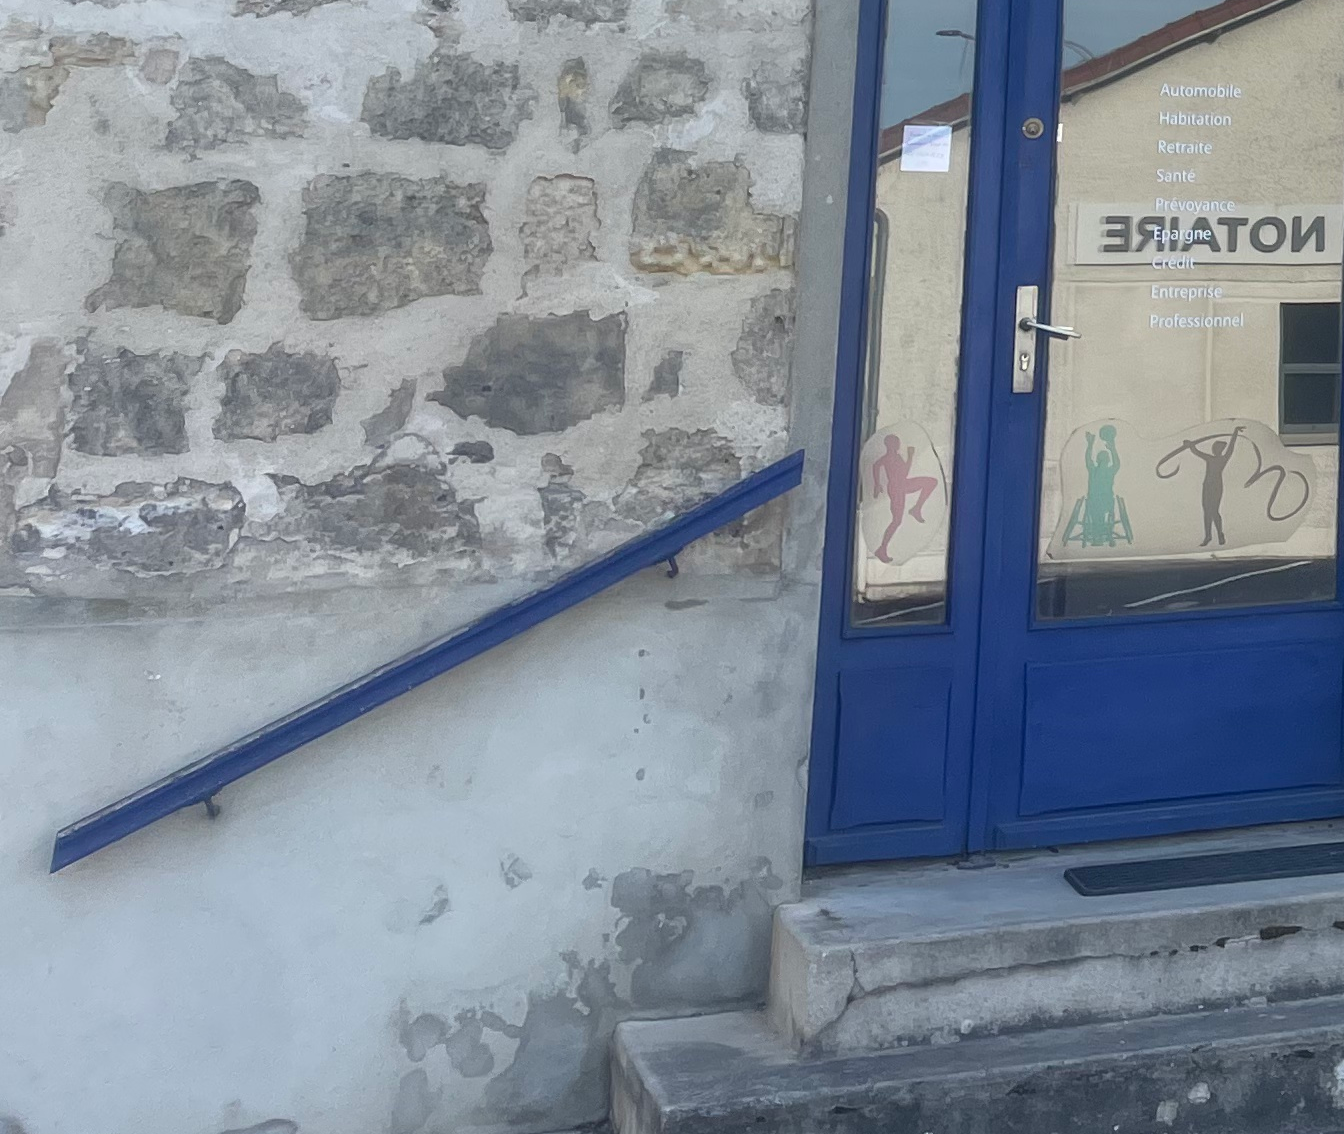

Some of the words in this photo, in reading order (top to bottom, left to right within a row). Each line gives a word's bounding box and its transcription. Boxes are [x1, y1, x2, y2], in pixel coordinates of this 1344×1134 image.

[1160, 82, 1242, 99] Automobile
[1159, 111, 1232, 127] Habitation
[1158, 140, 1212, 155] Retraite
[1156, 169, 1196, 183] Santé
[1155, 197, 1235, 215] Prévoyance
[1151, 255, 1195, 270] Crédit
[1151, 285, 1223, 301] Entreprise
[1150, 313, 1244, 328] Professionnel
